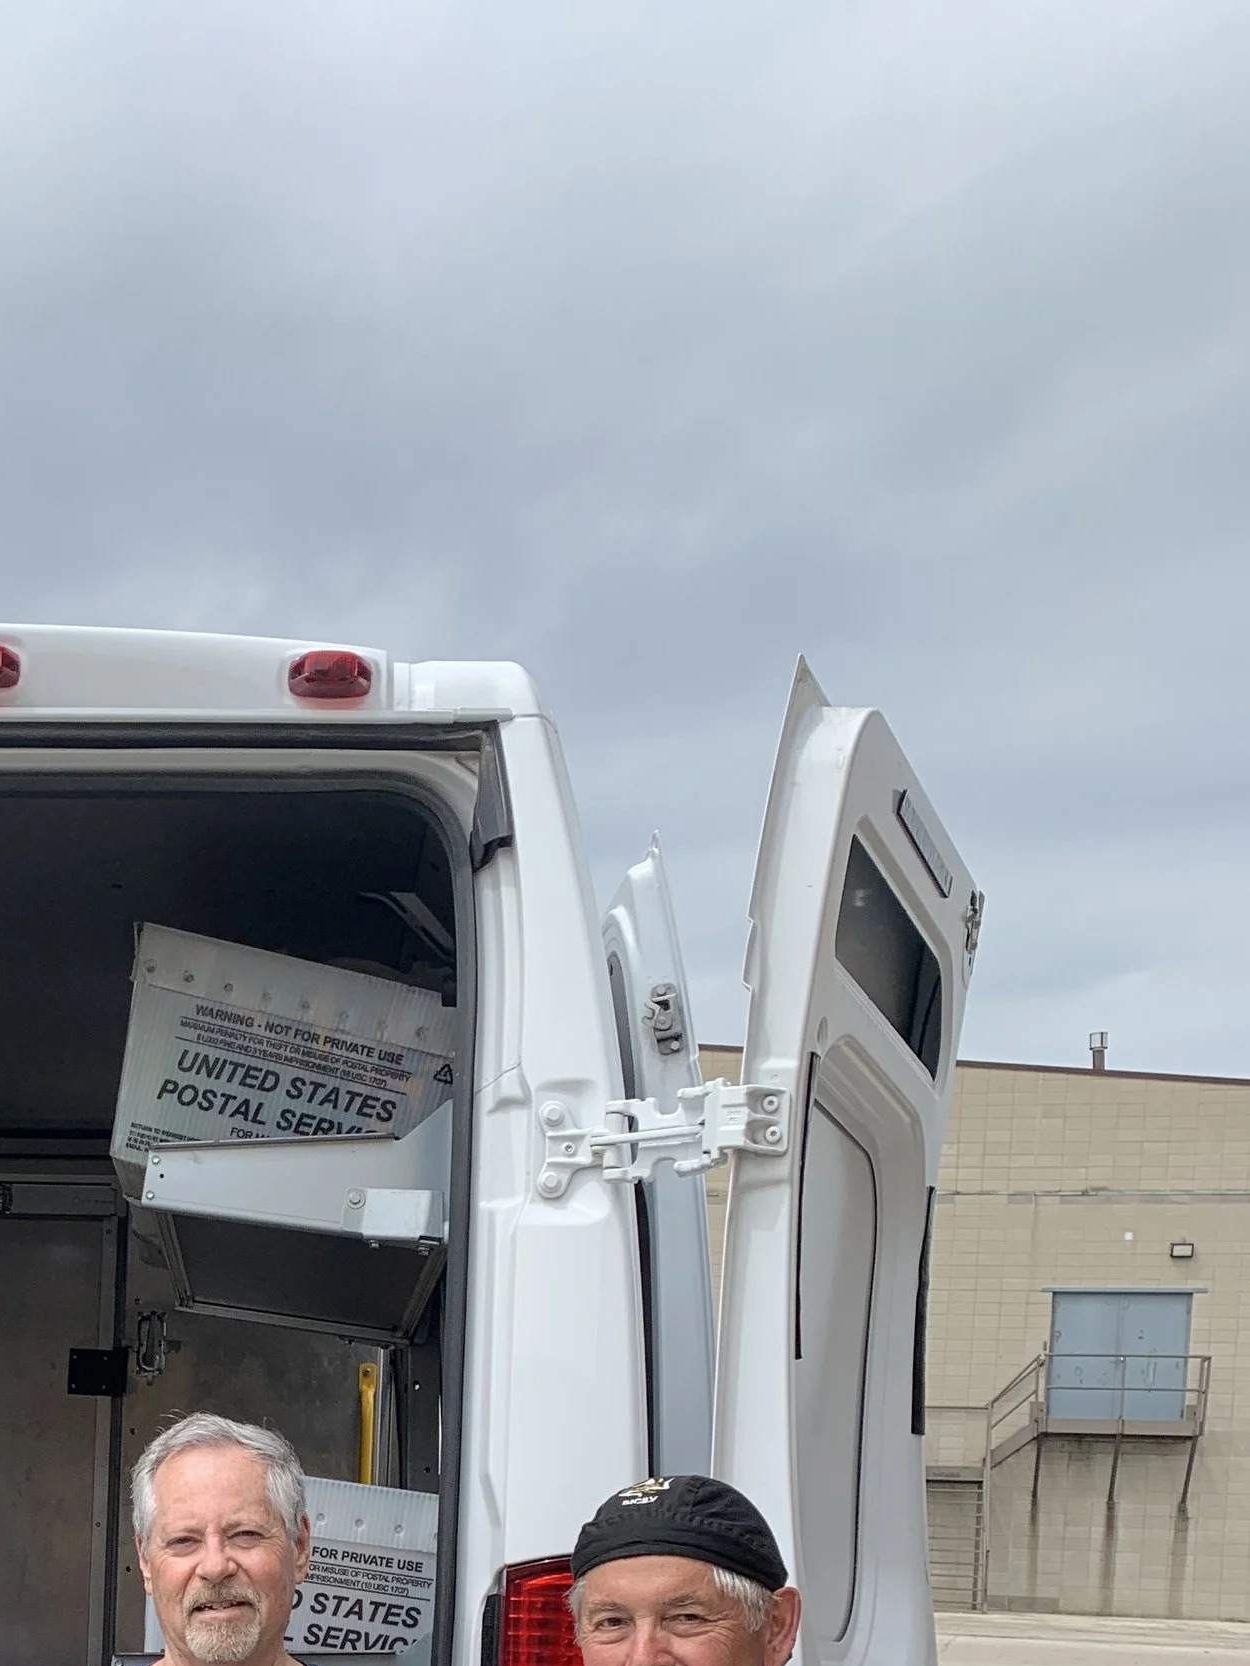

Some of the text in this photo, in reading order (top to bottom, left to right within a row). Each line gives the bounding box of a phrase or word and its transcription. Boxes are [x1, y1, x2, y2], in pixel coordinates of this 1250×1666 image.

[196, 1004, 405, 1065] WARNING NOT FOR PRIVATE USE
[156, 1079, 266, 1125] POSTAL
[178, 1050, 396, 1122] UNITED STATES
[309, 1564, 432, 1589] OR MISUSE OF POSTAL PROPERTY
[312, 1546, 423, 1573] FOR PRIVATE USE
[310, 1593, 422, 1628] STATES
[303, 1623, 418, 1653] SERVIC
